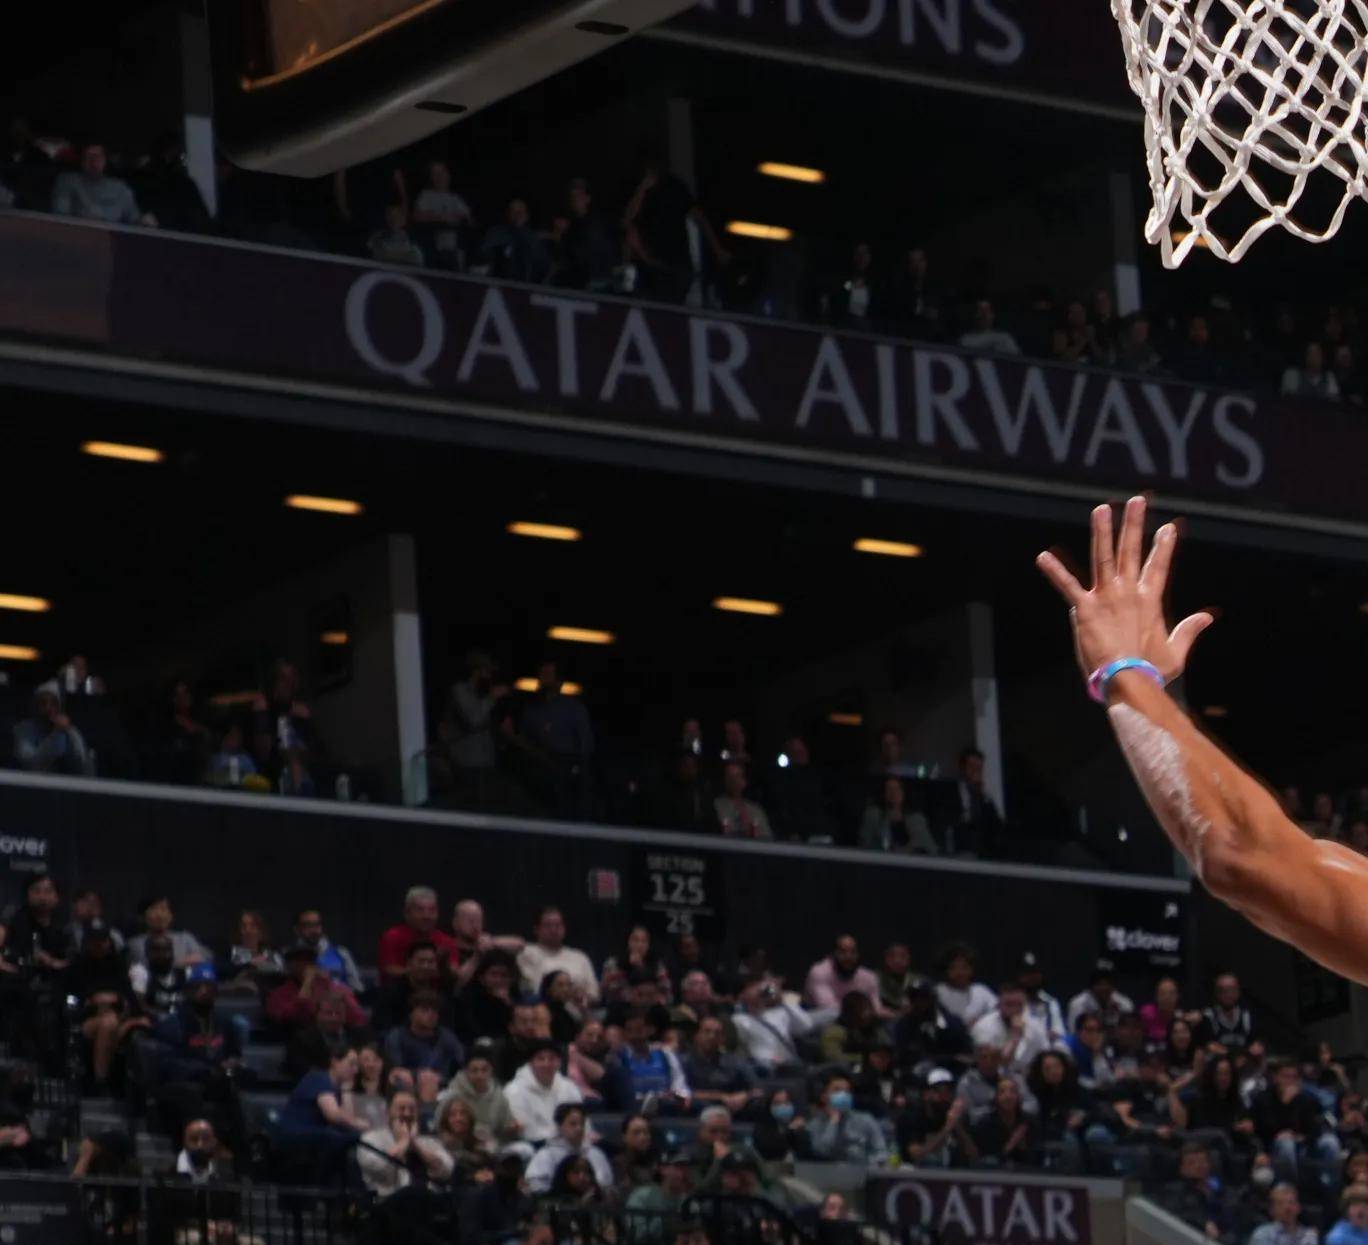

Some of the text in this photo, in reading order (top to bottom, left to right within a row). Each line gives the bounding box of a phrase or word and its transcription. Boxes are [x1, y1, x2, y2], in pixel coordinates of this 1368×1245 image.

[344, 270, 1266, 490] QATAR AIRWAYS
[651, 874, 706, 906] 125
